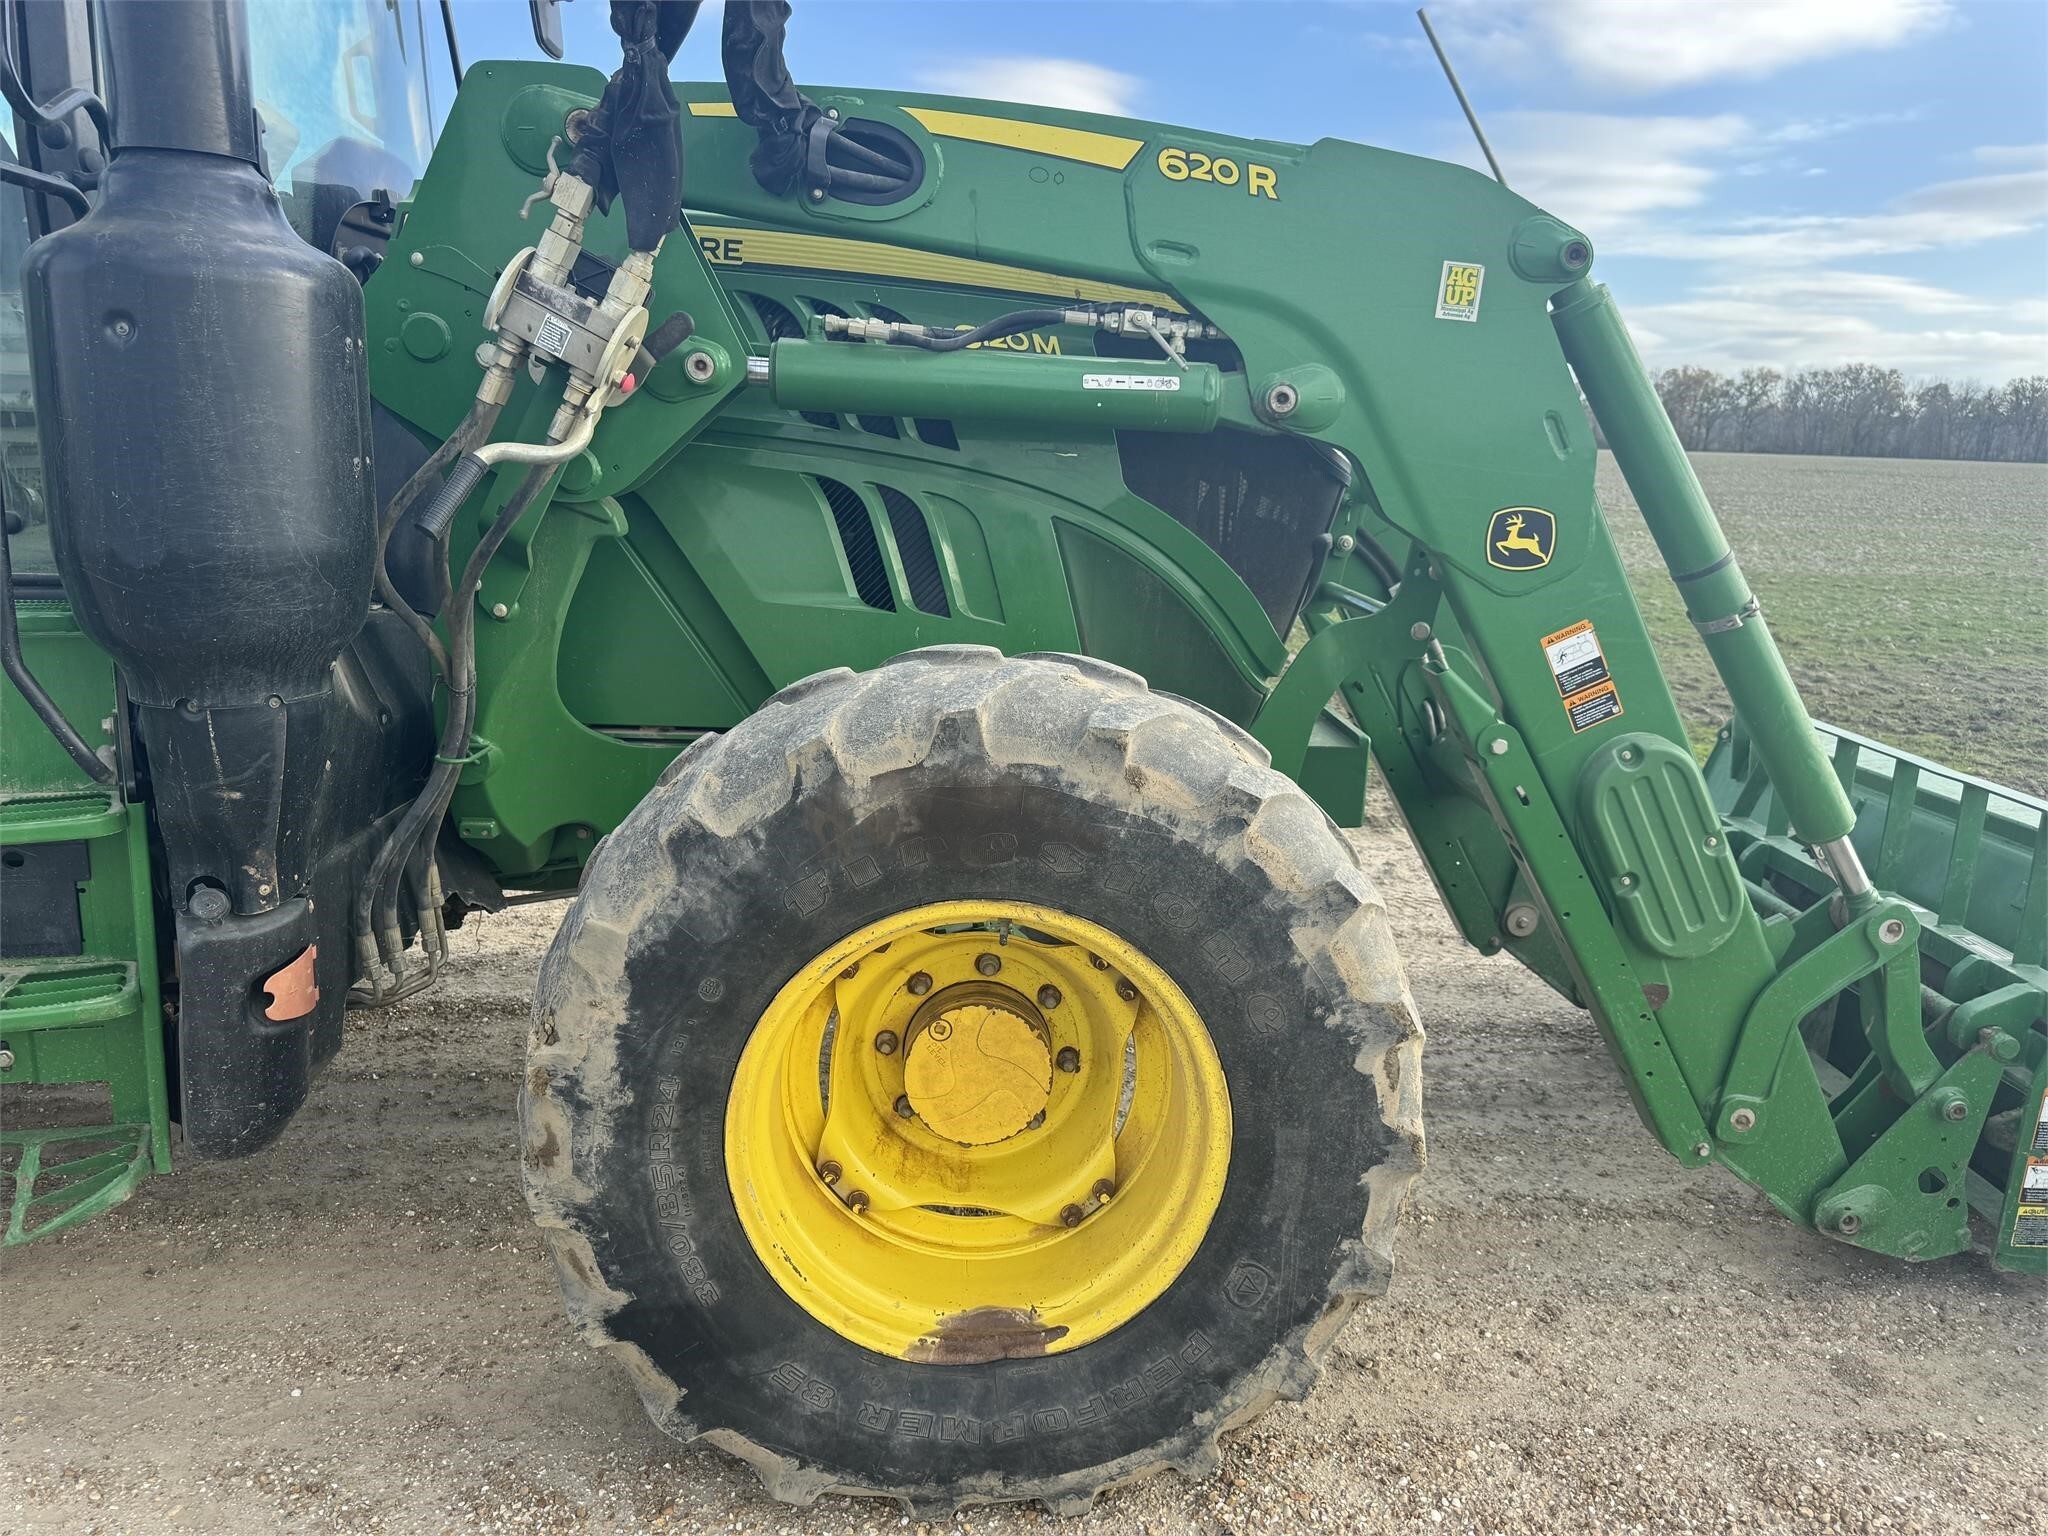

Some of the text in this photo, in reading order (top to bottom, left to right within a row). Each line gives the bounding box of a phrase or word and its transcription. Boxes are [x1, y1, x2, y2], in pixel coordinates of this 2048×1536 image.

[1157, 147, 1280, 201] 620 R
[1447, 266, 1478, 288] AG
[1445, 285, 1475, 306] UP
[1554, 624, 1586, 641] WARNING
[1577, 686, 1609, 702] WARNING
[856, 1331, 1215, 1446] PERFORMER
